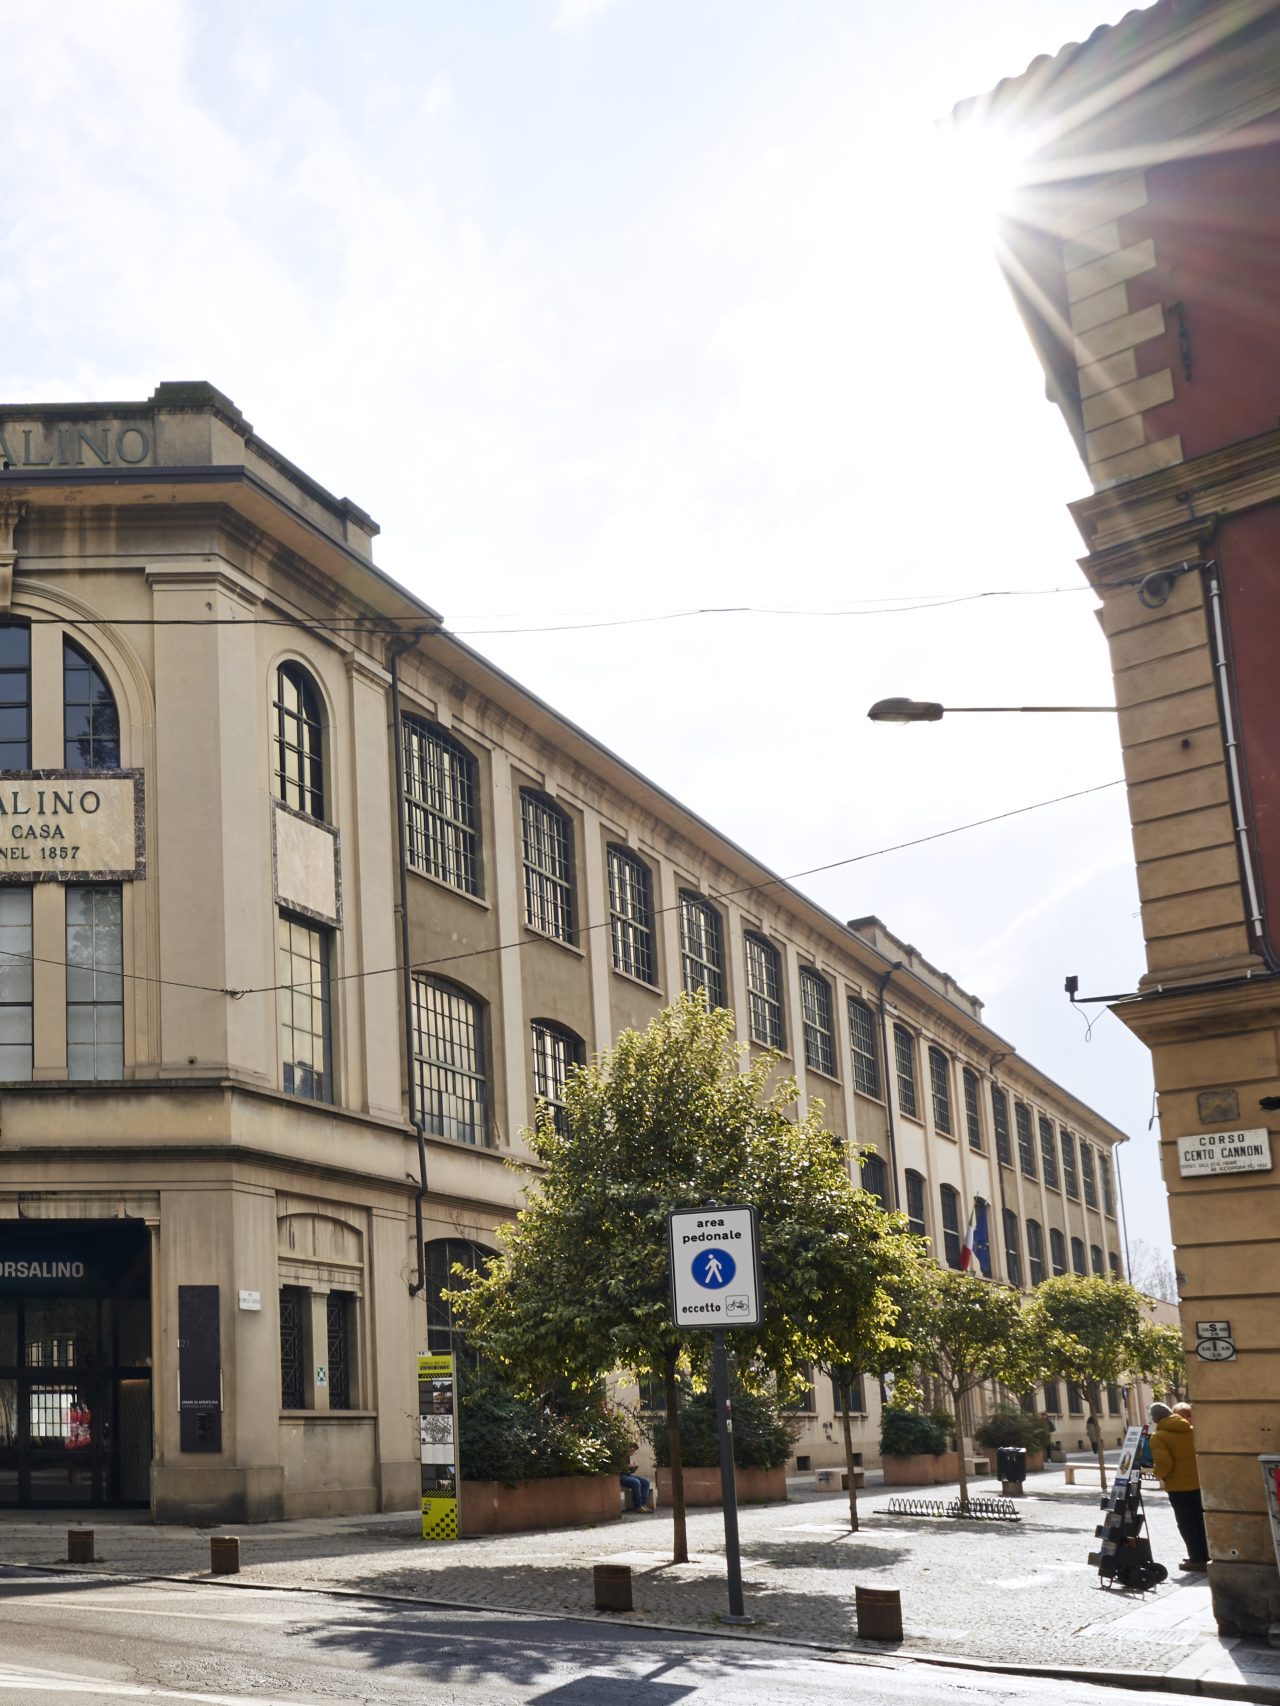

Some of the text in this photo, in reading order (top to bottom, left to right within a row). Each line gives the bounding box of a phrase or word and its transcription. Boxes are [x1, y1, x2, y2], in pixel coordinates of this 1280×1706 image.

[11, 824, 65, 839] CASA
[40, 846, 81, 860] 1857
[1199, 1133, 1245, 1146] CORSO
[1184, 1145, 1263, 1162] CENTO CANNONI
[696, 1219, 725, 1228] area
[682, 1230, 741, 1244] pedonale
[682, 1302, 721, 1314] eccetto
[1209, 1324, 1217, 1332] S
